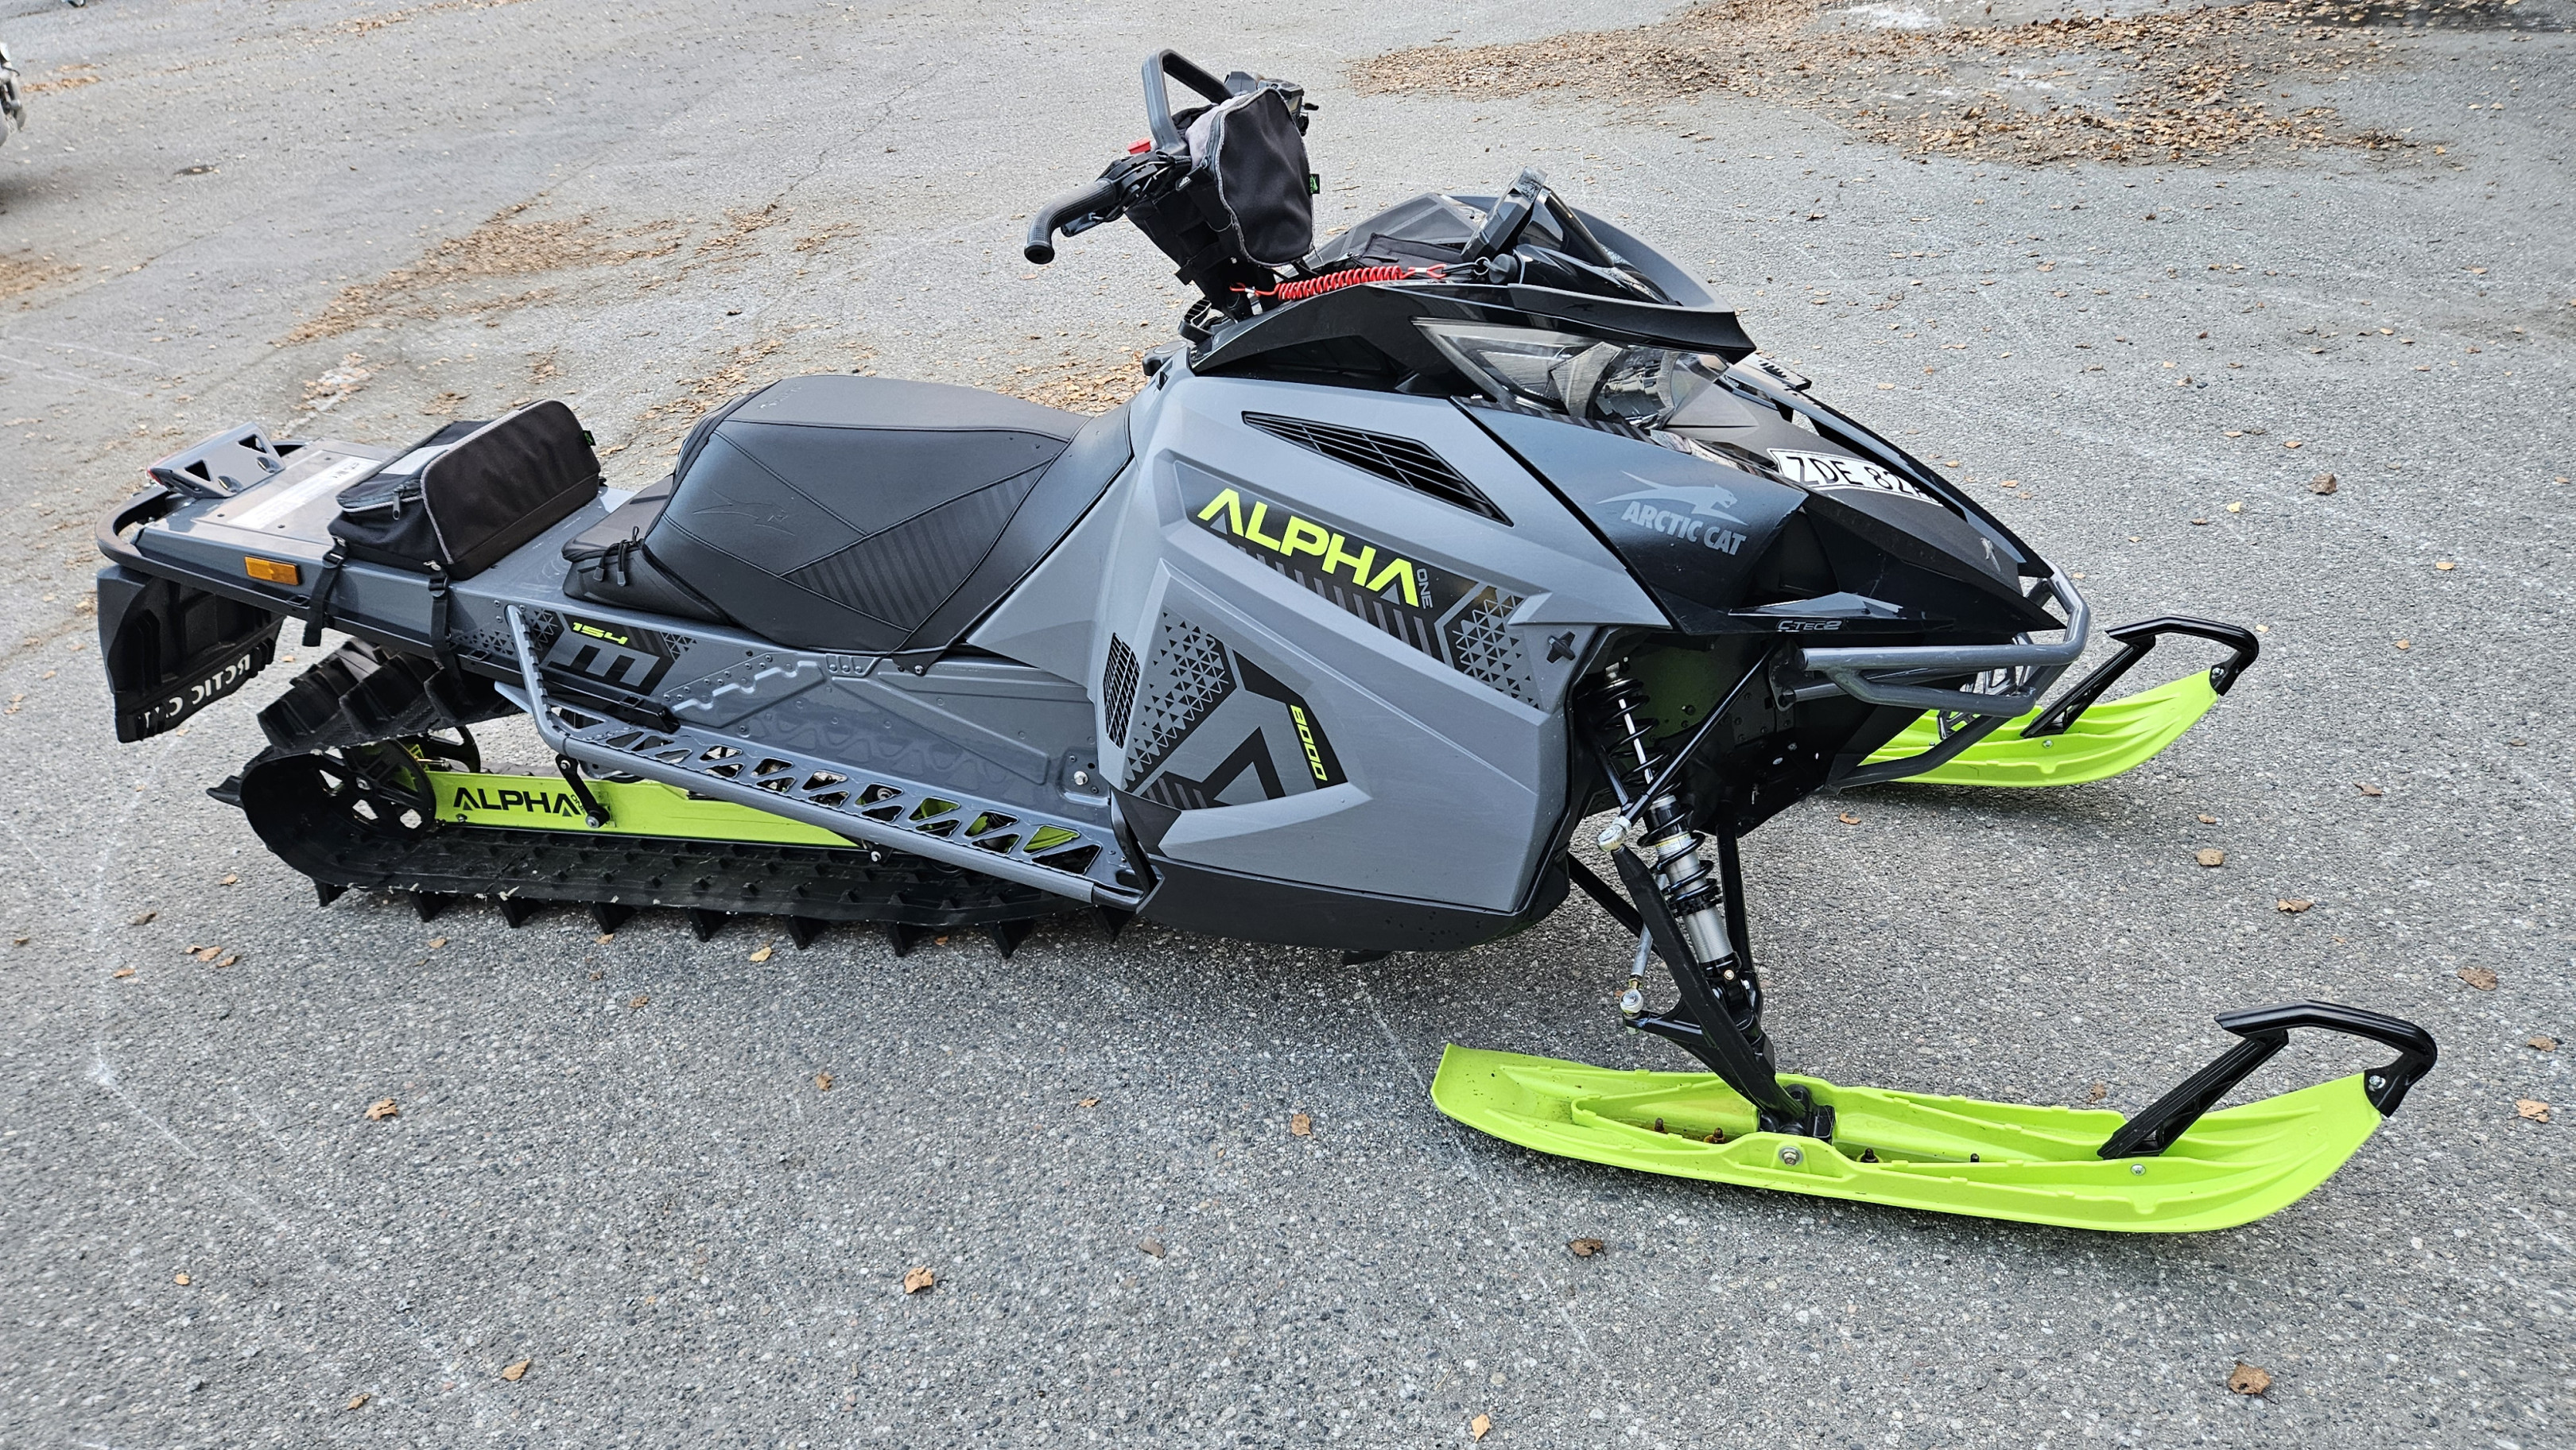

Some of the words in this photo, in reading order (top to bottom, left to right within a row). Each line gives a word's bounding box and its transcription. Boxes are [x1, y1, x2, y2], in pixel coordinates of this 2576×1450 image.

[1787, 456, 1864, 486] ZDE
[1197, 487, 1419, 607] ALPHA
[1417, 568, 1433, 609] ONE
[1621, 501, 1703, 542] ARCTIC
[1704, 526, 1747, 556] CAT
[572, 622, 628, 645] 154
[1290, 704, 1328, 781] 8000
[453, 787, 581, 816] ALPHA
